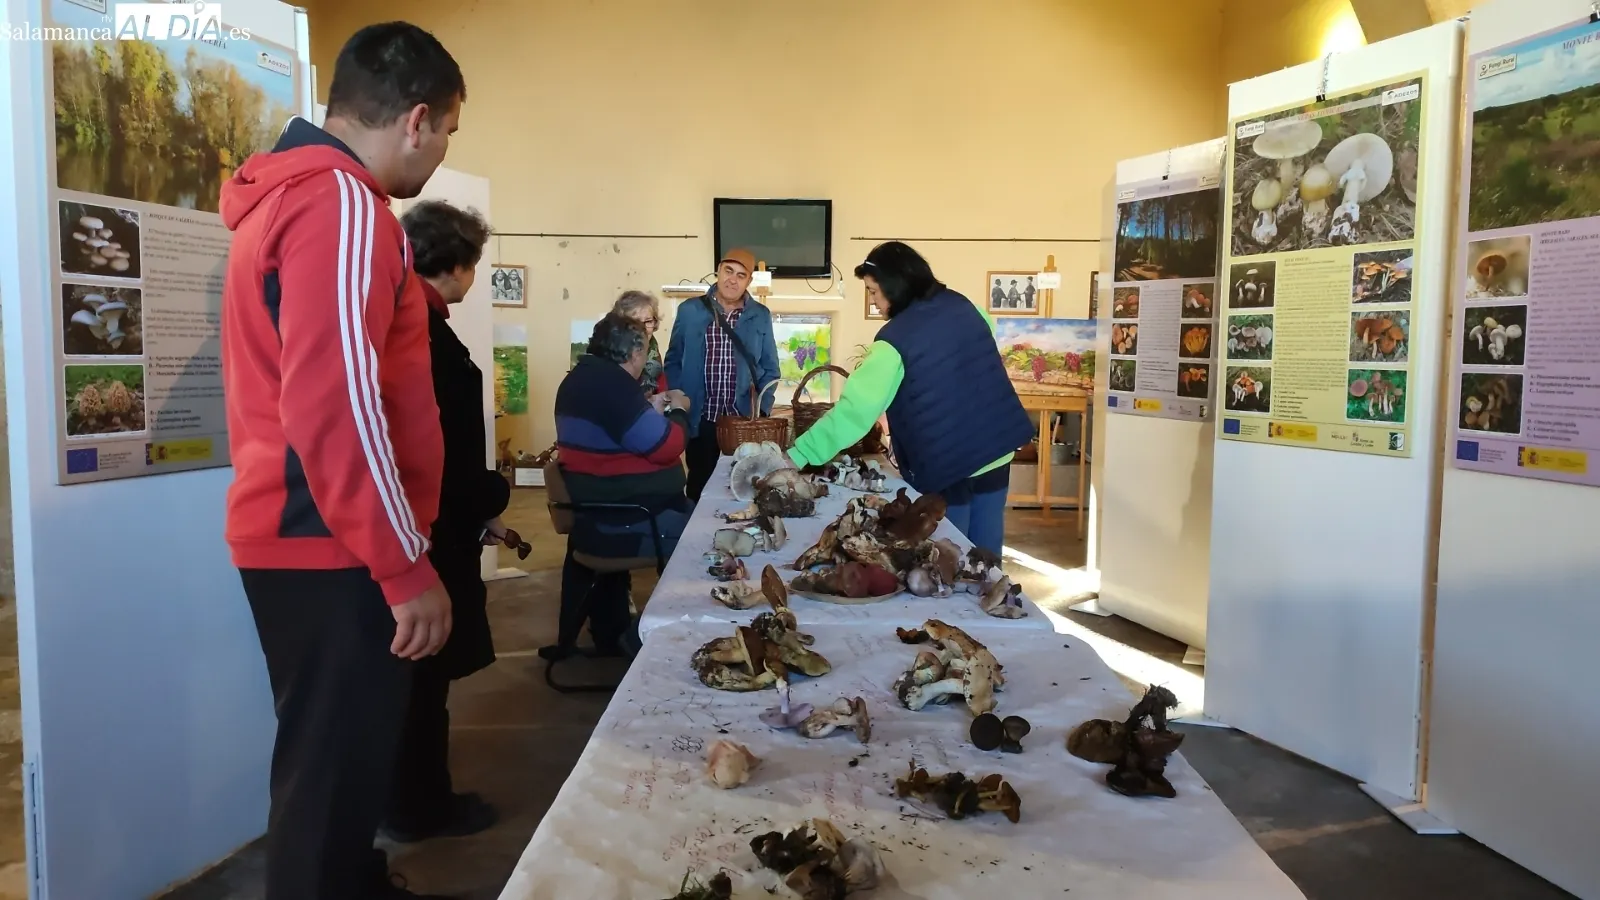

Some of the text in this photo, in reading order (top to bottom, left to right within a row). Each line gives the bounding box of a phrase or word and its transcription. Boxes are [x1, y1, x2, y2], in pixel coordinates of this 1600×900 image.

[1563, 34, 1593, 50] MONTE
[1489, 57, 1515, 69] Fungi Rural
[1395, 89, 1417, 98] ADEZOS
